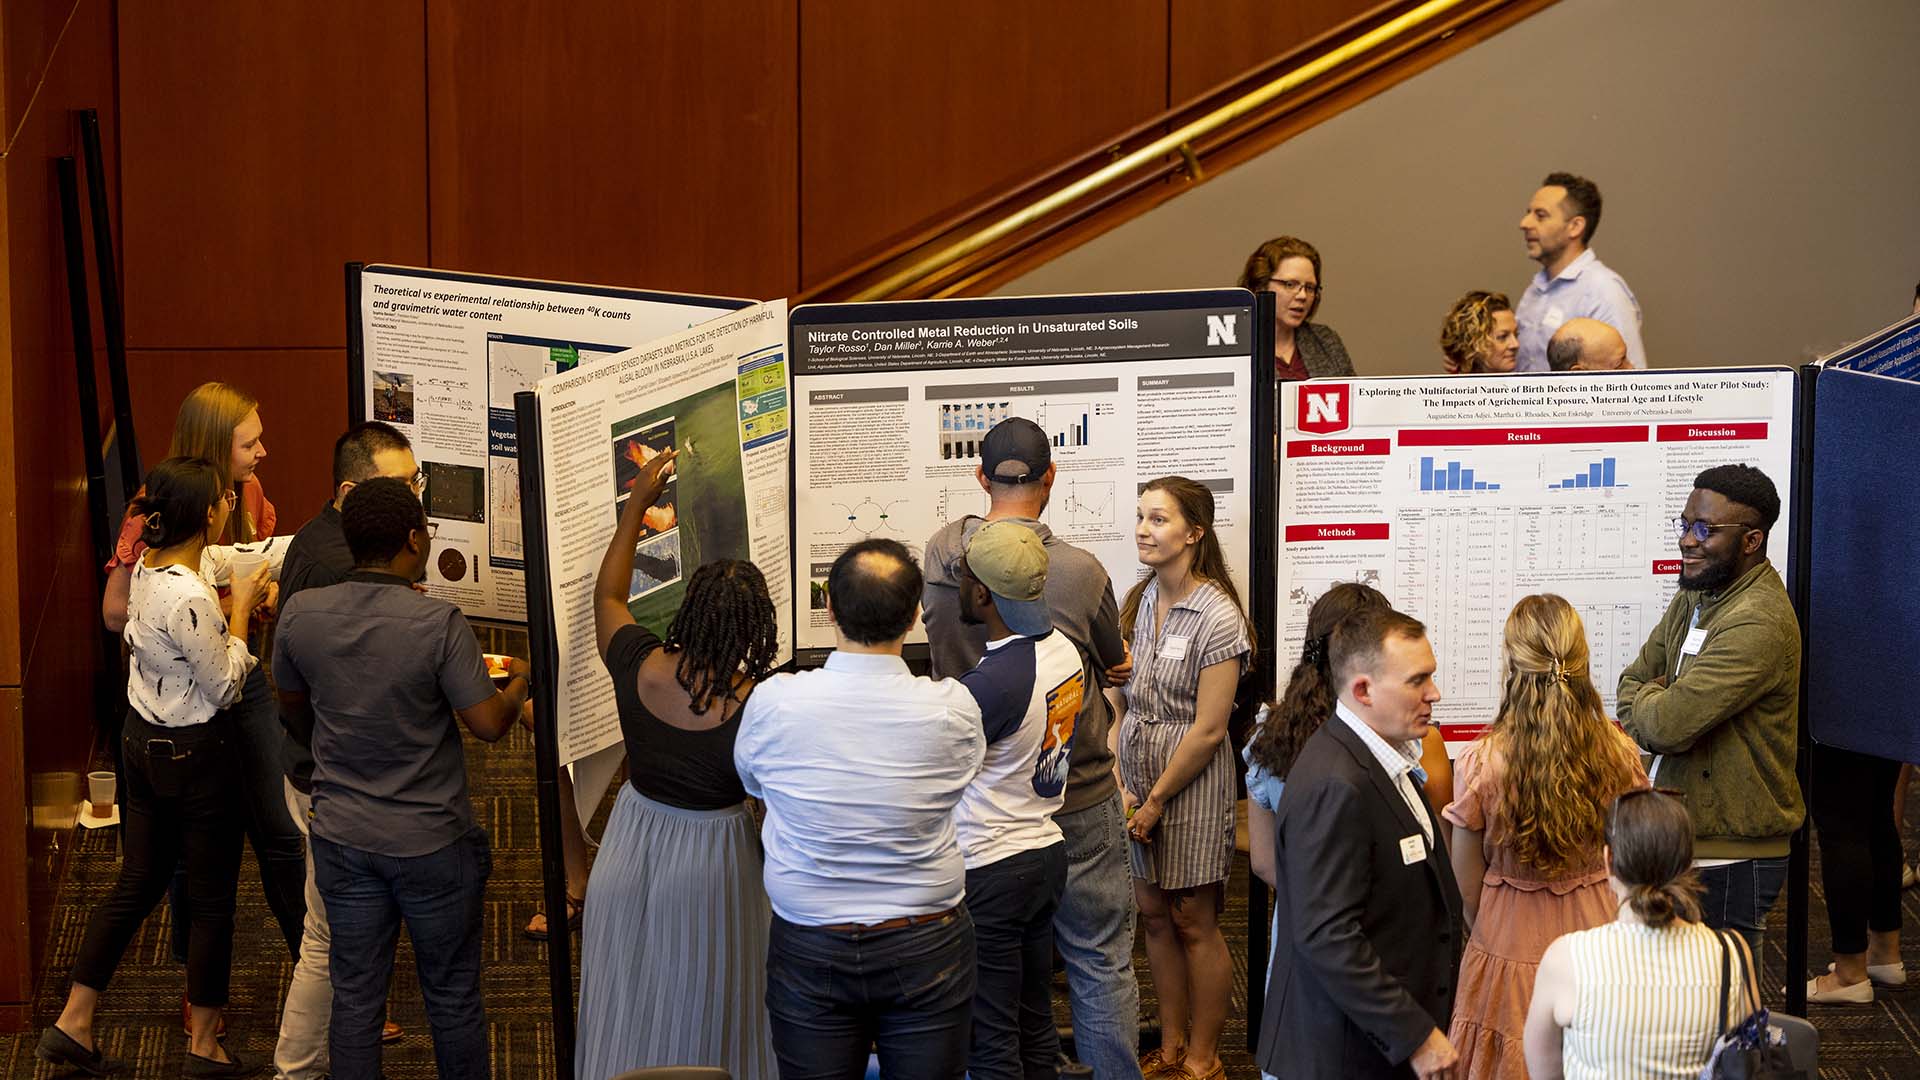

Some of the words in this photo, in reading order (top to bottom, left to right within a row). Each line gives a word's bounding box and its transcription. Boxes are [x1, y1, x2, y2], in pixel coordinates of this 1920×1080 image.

[373, 285, 420, 298] Theoretical
[434, 291, 491, 308] experimental
[492, 297, 544, 314] relationship
[547, 303, 584, 316] between
[602, 309, 631, 321] counts
[373, 300, 389, 310] and
[391, 302, 440, 318] gravimetric
[442, 307, 468, 318] water
[470, 310, 502, 322] content
[808, 331, 848, 342] Nitrate
[852, 328, 915, 341] Controlled
[918, 327, 950, 338] Metal
[954, 324, 1015, 337] Reduction
[1018, 324, 1029, 334] in
[1032, 321, 1105, 334] Unsaturated
[1108, 320, 1138, 331] Soils
[1207, 315, 1238, 346] N
[552, 375, 587, 396] COMPARISON
[588, 373, 594, 383] OF
[595, 364, 620, 381] REMOTELY
[621, 357, 639, 372] SENSED
[640, 348, 663, 365] DATASETS
[664, 344, 675, 356] AND
[675, 337, 696, 352] METRICS
[696, 333, 706, 345] FOR
[706, 330, 716, 342] THE
[716, 321, 741, 338] DETECTION
[742, 318, 749, 329] OF
[750, 311, 774, 324] HARMFUL
[809, 344, 836, 356] Taylor
[874, 342, 892, 352] Dan
[926, 340, 953, 349] Karrie
[954, 340, 964, 348] A.
[618, 372, 634, 385] ALGAL
[635, 366, 653, 380] BLOOM
[654, 364, 659, 373] IN
[700, 345, 714, 358] LAKES
[1359, 387, 1401, 398] Exploring
[1404, 387, 1416, 395] the
[1420, 386, 1477, 395] Multifactorial
[1480, 386, 1509, 394] Nature
[1512, 385, 1520, 393] of
[1523, 385, 1544, 393] Birth
[1547, 384, 1577, 393] Defects
[1580, 384, 1587, 392] in
[1590, 384, 1603, 392] the
[1606, 384, 1628, 392] Birth
[1630, 383, 1672, 392] Outcomes
[1674, 383, 1690, 391] and
[1692, 382, 1718, 390] Water
[1721, 382, 1739, 390] Pilot
[1742, 381, 1769, 392] Study:
[551, 400, 576, 413] INTRODUCTION
[1306, 393, 1341, 424] N
[1423, 399, 1439, 407] The
[1442, 398, 1475, 408] Impacts
[1489, 397, 1544, 407] Agrichemical
[1591, 395, 1630, 404] Maternal
[1632, 395, 1647, 405] Age
[1650, 395, 1665, 403] and
[1668, 394, 1704, 404] Lifestyle
[1602, 409, 1631, 417] University
[490, 429, 516, 440] Vegetat
[1507, 432, 1541, 441] Results
[1688, 428, 1736, 437] Discussion
[1311, 444, 1364, 453] Background
[1318, 528, 1356, 537] Methods
